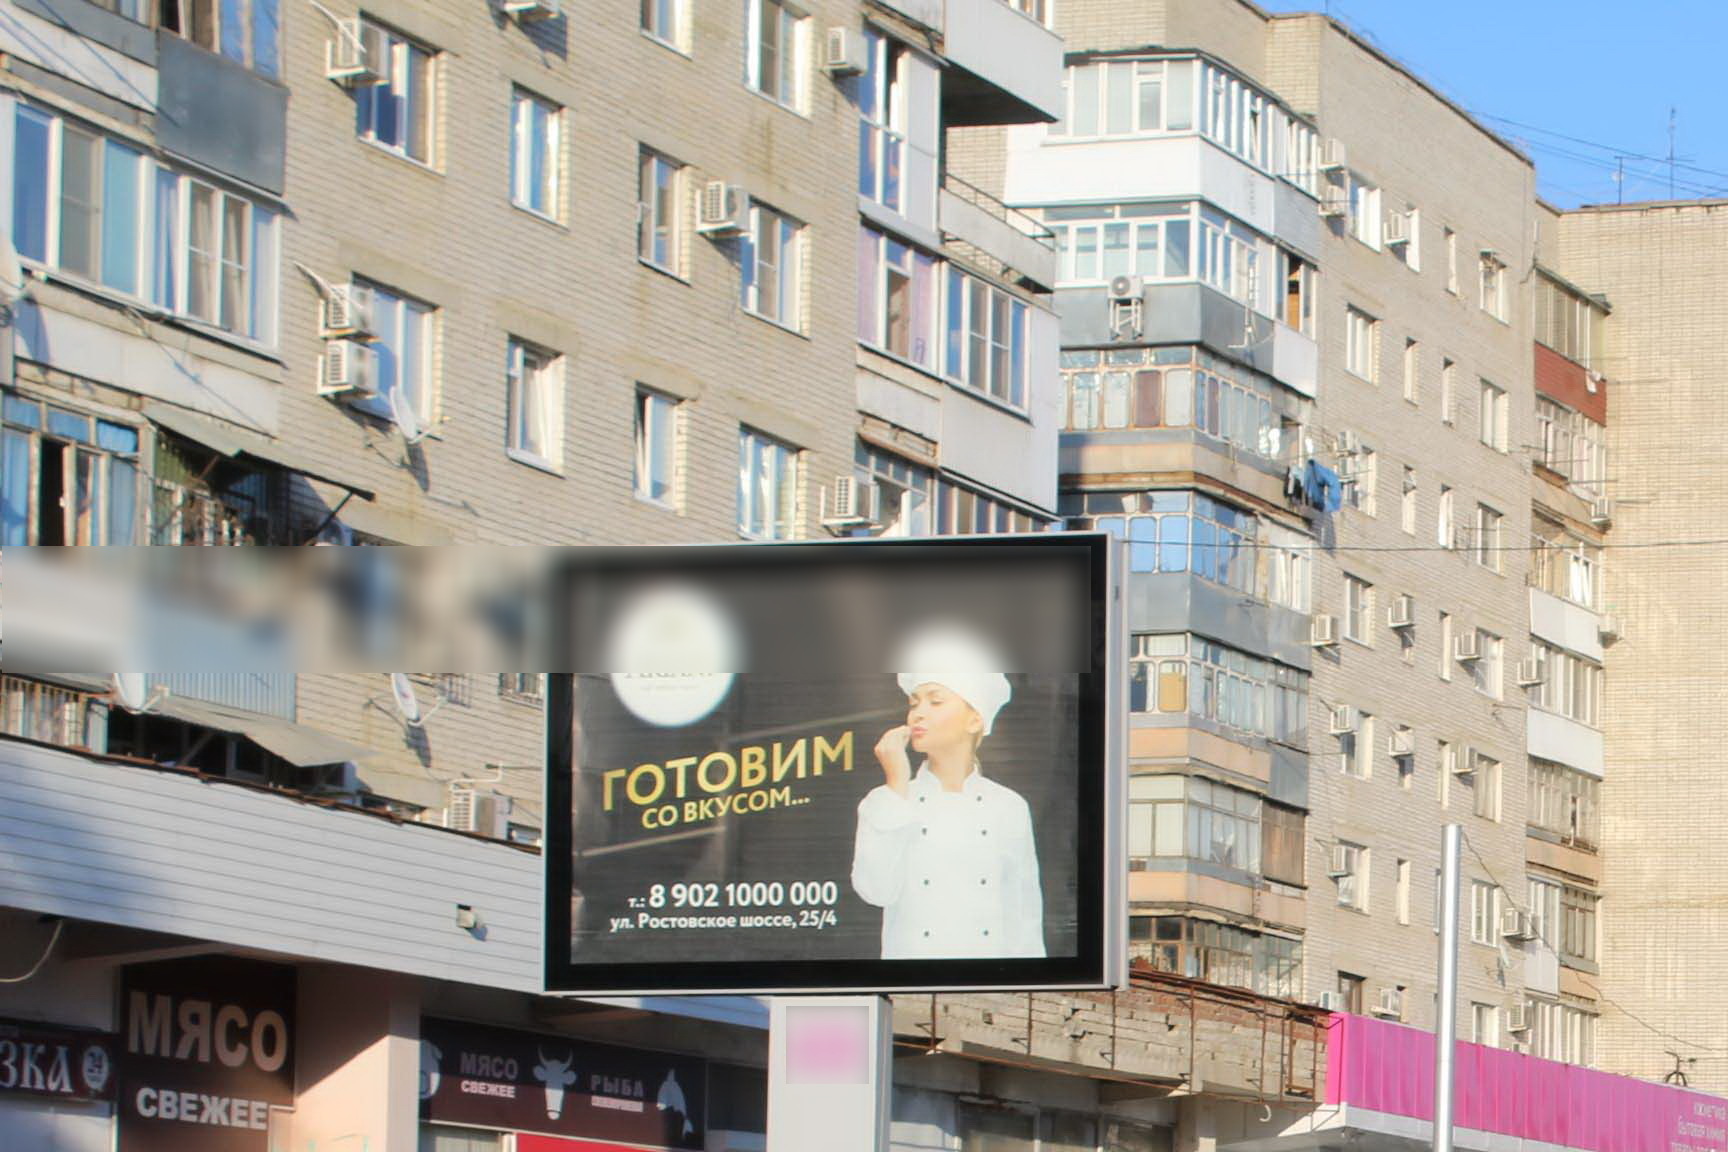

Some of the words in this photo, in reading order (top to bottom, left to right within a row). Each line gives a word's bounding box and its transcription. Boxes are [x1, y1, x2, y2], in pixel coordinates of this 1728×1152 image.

[603, 731, 853, 811] ГОТОВИМ
[641, 805, 678, 829] СО
[649, 884, 666, 908] 8
[671, 883, 719, 908] 902
[725, 882, 784, 907] 1000
[790, 881, 838, 906] 000
[610, 918, 635, 933] ул.
[638, 913, 737, 929] Ростовское
[740, 915, 797, 930] шоссе,
[800, 910, 838, 931] 25/4
[127, 991, 288, 1073] МЯСО
[460, 1052, 519, 1080] МЯСО
[460, 1079, 517, 1099] СВЕЖЕЕ
[590, 1074, 644, 1098] РЫБА
[136, 1087, 269, 1131] СВЕЖЕЕ
